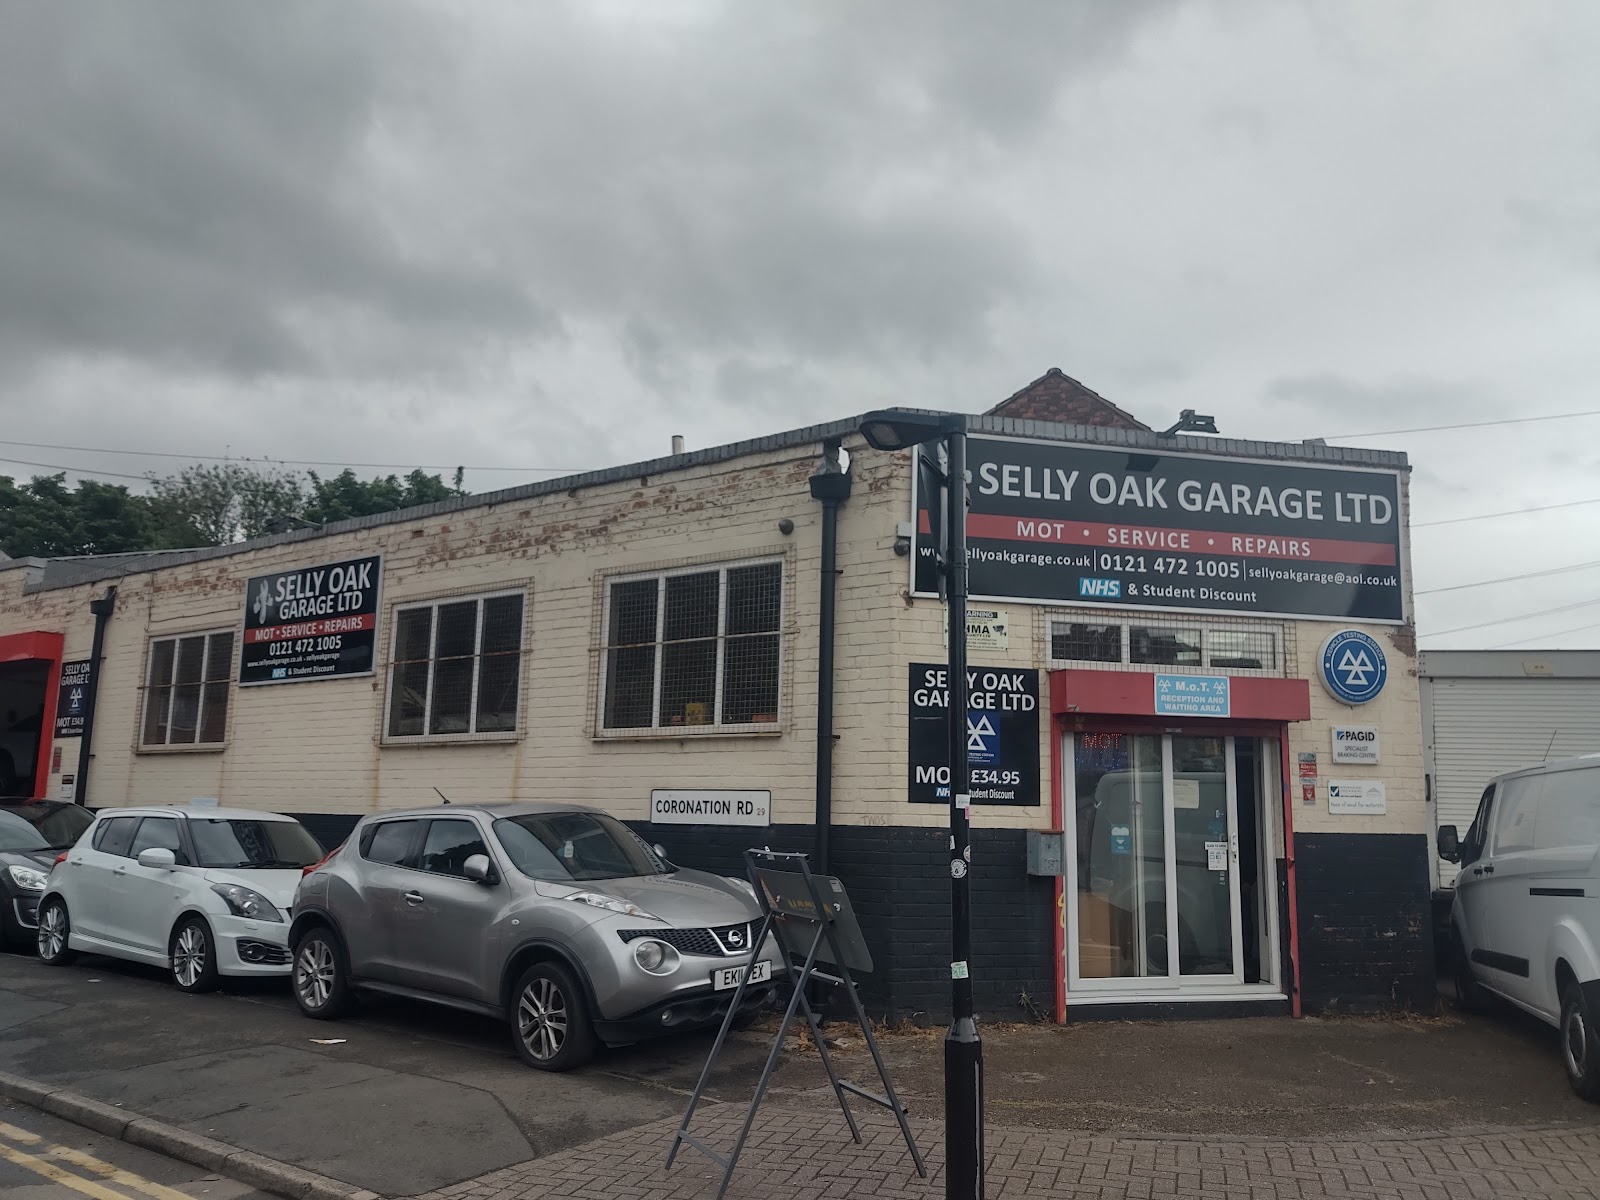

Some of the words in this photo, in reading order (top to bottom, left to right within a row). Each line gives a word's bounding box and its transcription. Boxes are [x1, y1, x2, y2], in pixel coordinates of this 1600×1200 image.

[978, 462, 1079, 501] SELLY
[1089, 472, 1168, 508] OAK
[1177, 480, 1323, 520] GARAGE
[1335, 491, 1392, 524] LTD
[1017, 520, 1064, 539] MOT
[1107, 527, 1190, 548] SERVICE
[1232, 536, 1311, 557] REPAIRS
[1100, 553, 1147, 572] 0121
[1153, 556, 1188, 575] 472
[1195, 559, 1240, 578] 1005
[1248, 567, 1397, 587] sellyoakgarage@aol.co.uk
[275, 569, 325, 602] SELLY
[328, 562, 372, 594] OAK
[1081, 579, 1120, 596] NHS
[1127, 582, 1138, 595] &
[1143, 582, 1195, 599] Student
[1200, 587, 1256, 602] Discount
[279, 594, 335, 620] GARAGE
[337, 591, 363, 612] LTD
[255, 628, 275, 641] MOT
[281, 622, 316, 638] SERVICE
[324, 616, 363, 633] REPAIRS
[269, 641, 293, 656] 0121
[295, 638, 314, 652] 472
[316, 635, 342, 651] 1005
[65, 663, 80, 675] SELLY
[81, 663, 90, 673] OA
[272, 667, 287, 679] NHS
[293, 666, 312, 675] Student
[313, 665, 335, 674] Discount
[61, 674, 85, 686] GARAGE
[924, 670, 978, 689] SEY
[982, 673, 1025, 692] OAK
[1175, 681, 1210, 692] M.o.T.
[1002, 693, 1036, 711] LTD
[1160, 694, 1206, 703] RECEPTION
[1207, 696, 1225, 704] AND
[1164, 704, 1198, 712] WAITING
[57, 717, 71, 728] MOT
[1084, 733, 1122, 749] MOT
[1345, 731, 1375, 742] PAGID
[915, 765, 950, 784] MO
[971, 769, 1020, 785] £34.95
[936, 787, 950, 797] NH
[969, 788, 988, 798] tudent
[989, 788, 1015, 800] Discount
[656, 800, 731, 815] CORONATION
[737, 800, 753, 815] RD
[756, 807, 766, 816] 29
